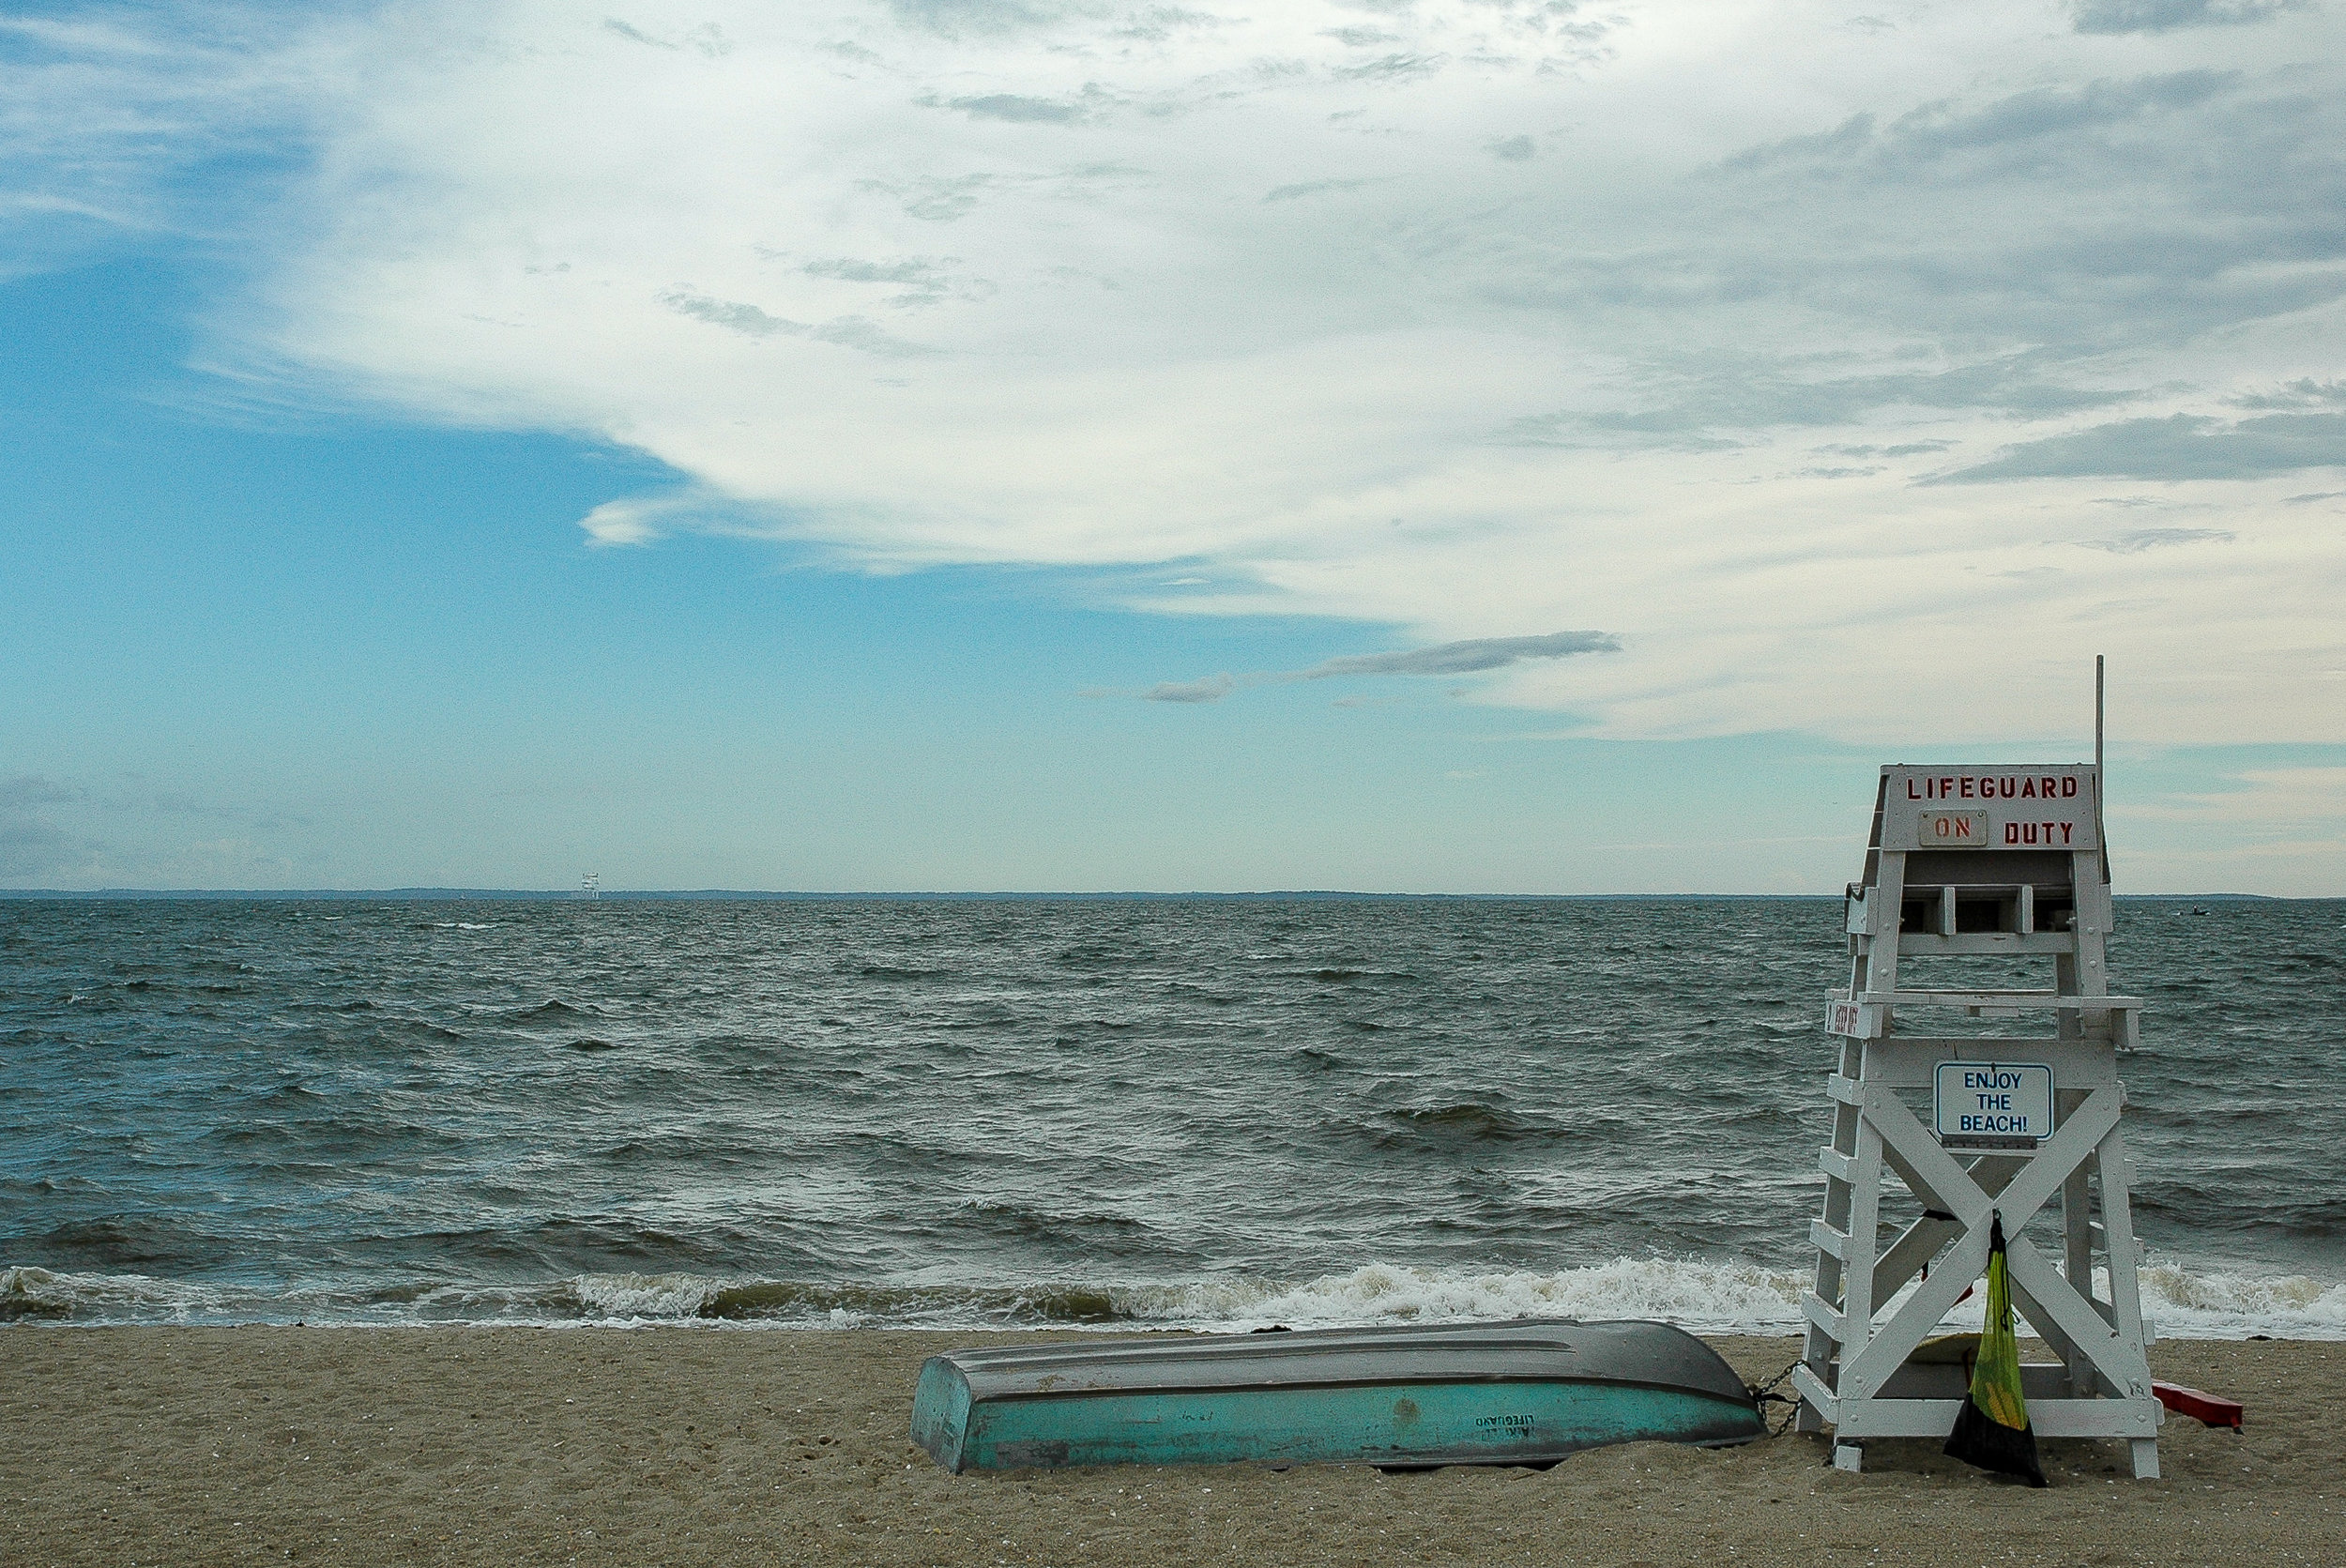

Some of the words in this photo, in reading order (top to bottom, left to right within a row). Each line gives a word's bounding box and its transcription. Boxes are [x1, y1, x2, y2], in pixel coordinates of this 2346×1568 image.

[1907, 777, 2078, 799] LIFEGUARD
[1935, 817, 1970, 838] ON
[2004, 822, 2073, 845] DUTY
[1964, 1073, 2022, 1089] ENJOY
[1976, 1093, 2012, 1110] THE
[1960, 1115, 2027, 1132] BEACH!
[1475, 1414, 1534, 1426] LIFEGUARD
